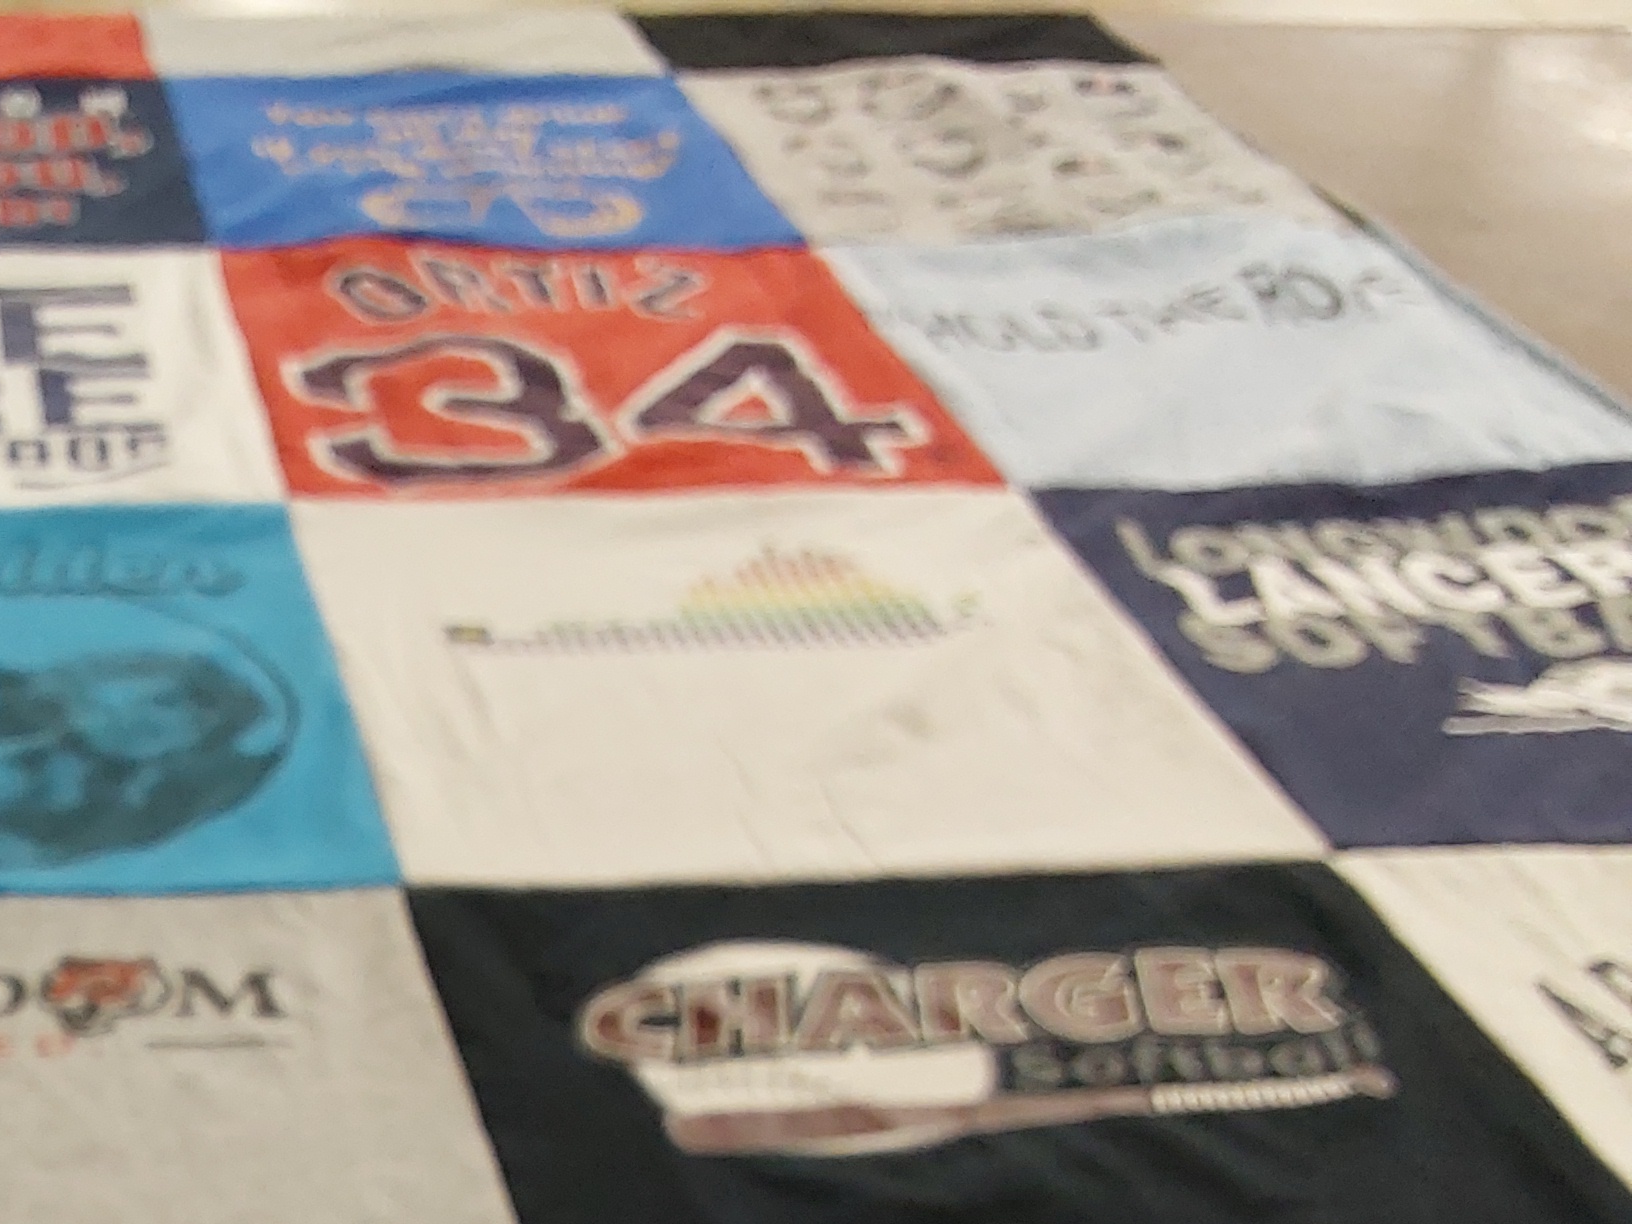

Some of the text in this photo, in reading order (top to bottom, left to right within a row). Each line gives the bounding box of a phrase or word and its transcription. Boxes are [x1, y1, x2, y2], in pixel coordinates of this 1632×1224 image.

[328, 250, 710, 322] ORTIZ
[282, 328, 932, 490] 34
[582, 946, 1348, 1062] CHARGER
